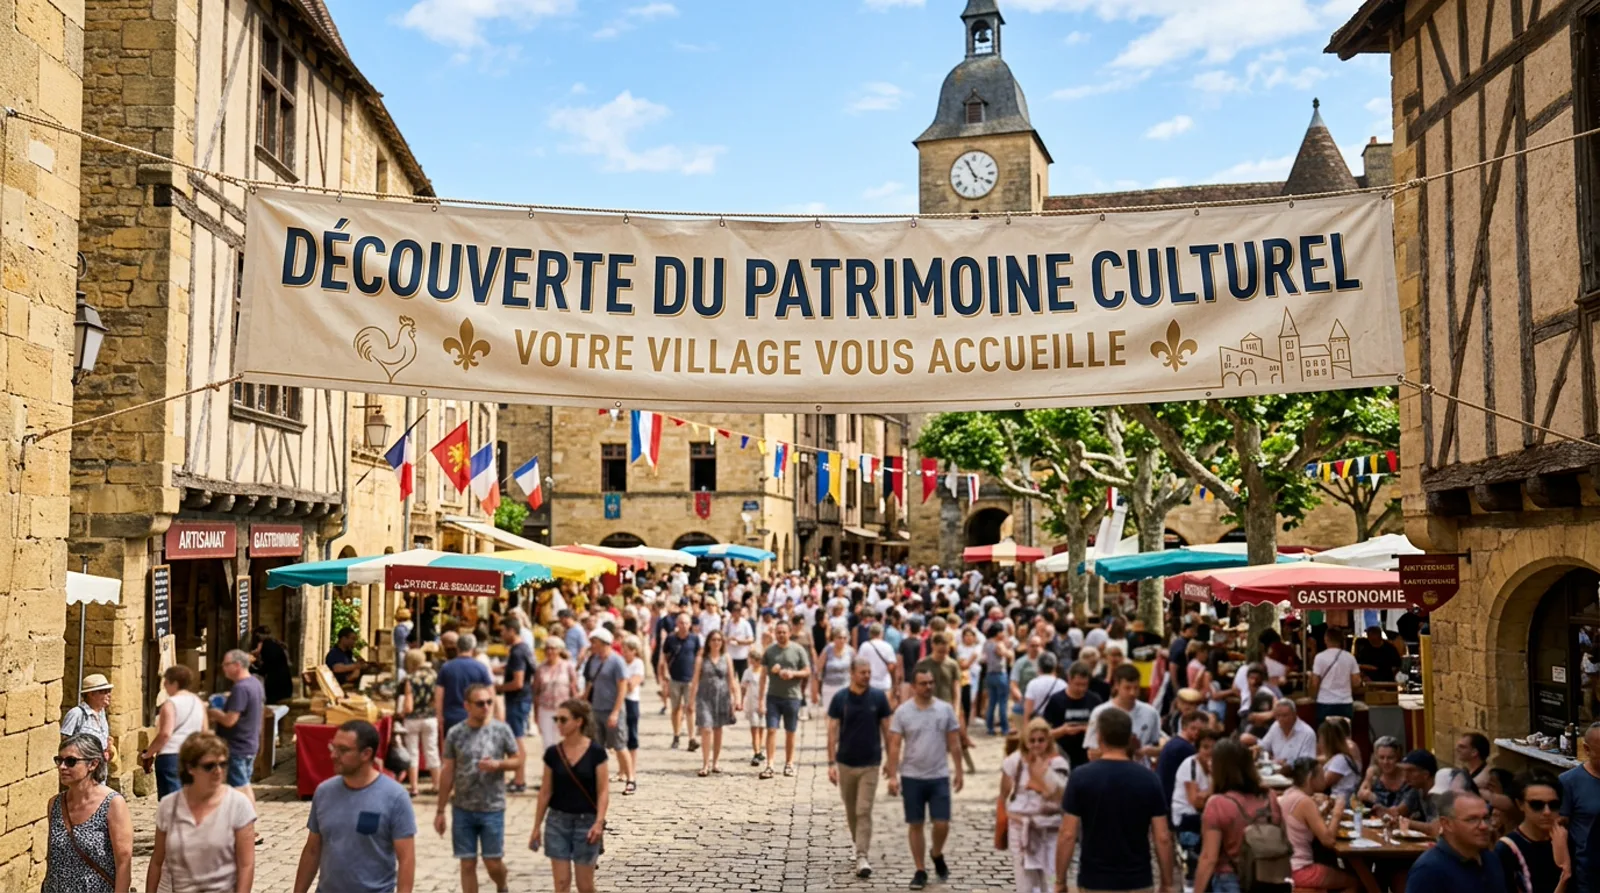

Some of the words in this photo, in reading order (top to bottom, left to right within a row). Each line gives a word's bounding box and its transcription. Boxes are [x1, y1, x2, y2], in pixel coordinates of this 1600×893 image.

[281, 218, 635, 316] DÉCOUVERTE
[653, 256, 726, 318] DU
[745, 253, 1077, 319] PATRIMOINE
[1091, 232, 1361, 309] CULTUREL
[515, 329, 634, 371] VOTRE
[647, 337, 801, 375] VILLAGE
[815, 339, 915, 376] VOUS
[928, 330, 1127, 374] ACCUEILLE
[178, 530, 227, 550] ARTISANAT
[1297, 589, 1407, 605] GASTRONOMIE
